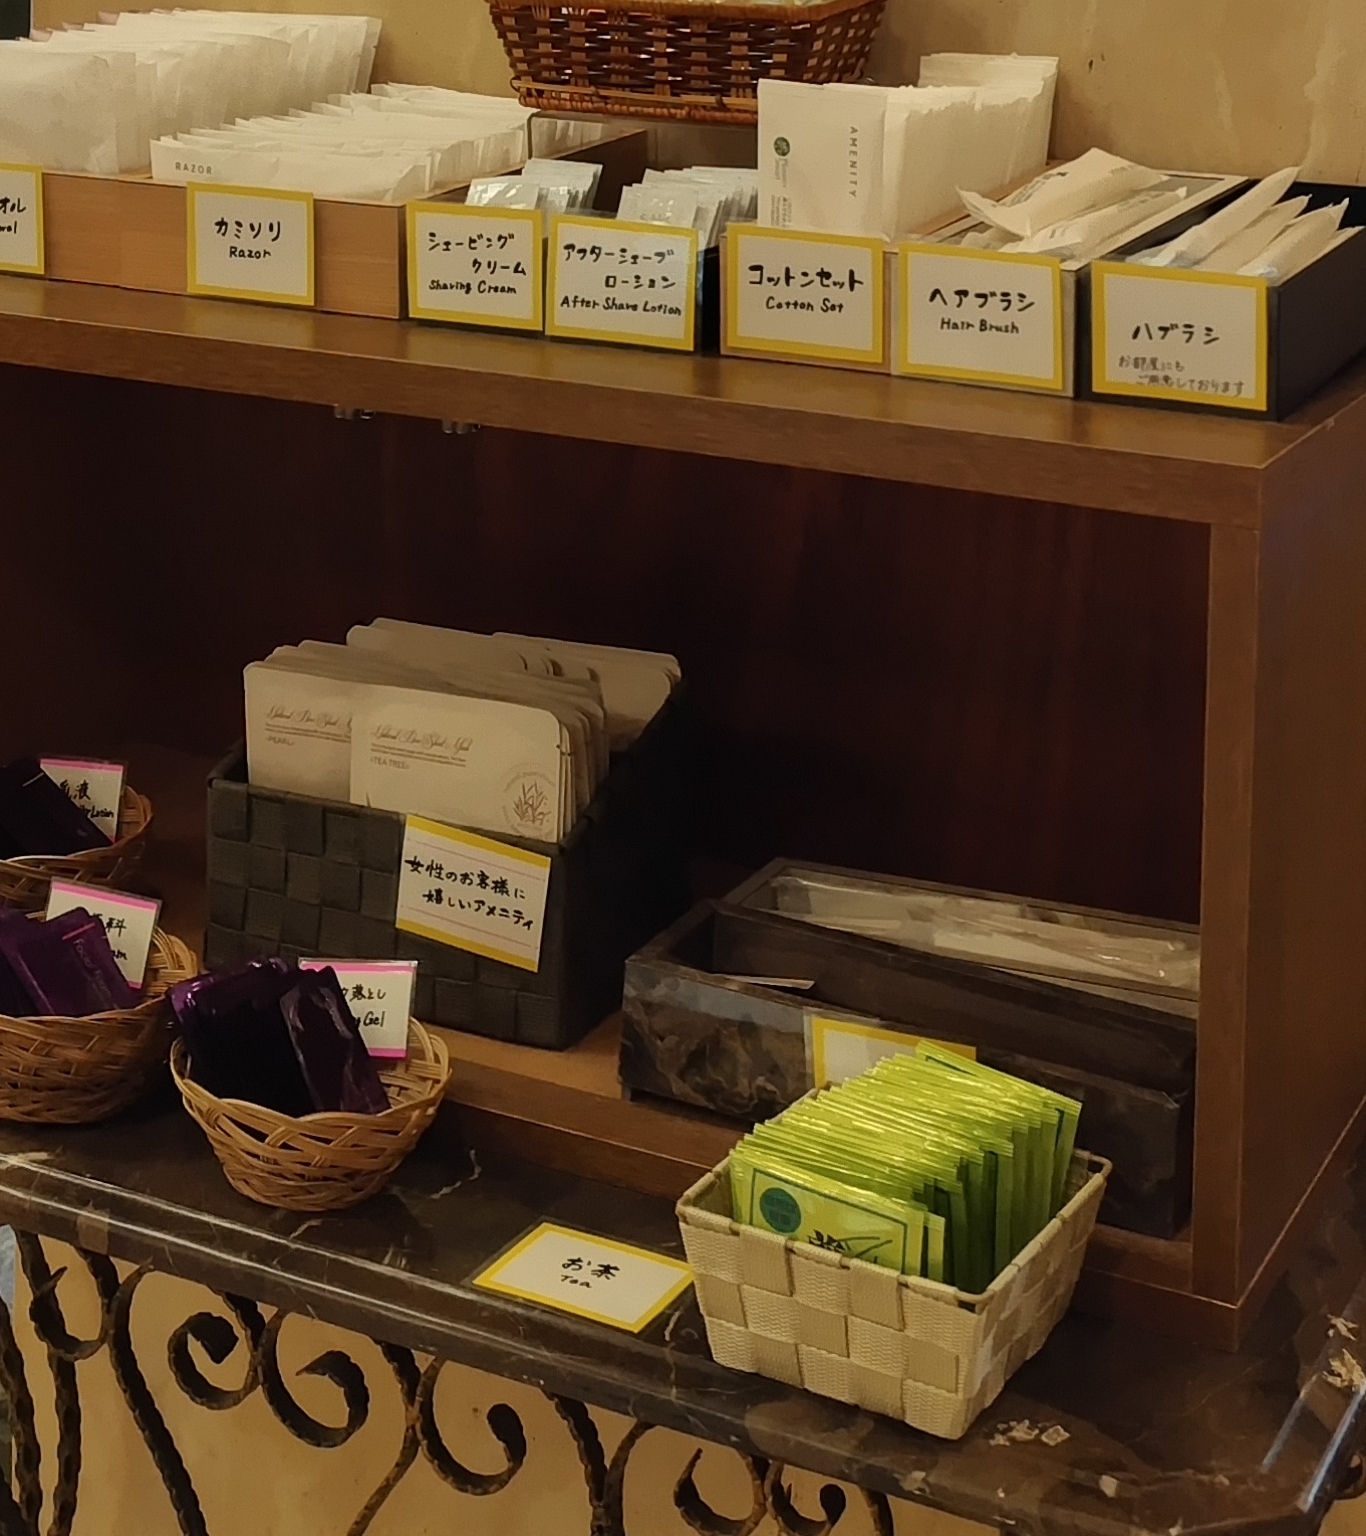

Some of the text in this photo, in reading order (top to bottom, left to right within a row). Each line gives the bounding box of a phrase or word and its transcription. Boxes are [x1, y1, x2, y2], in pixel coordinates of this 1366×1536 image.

[175, 162, 211, 175] RAZOR
[849, 127, 858, 197] AMENITY
[215, 217, 280, 242] カミソリ
[429, 232, 514, 251] シェービング
[229, 245, 272, 260] Razor
[563, 244, 674, 264] アフターシェーブ
[472, 258, 526, 275] クリーム
[429, 280, 516, 294] Shaving Cream
[605, 275, 675, 289] ローション
[748, 265, 863, 292] コットンセット
[560, 295, 681, 316] After Shave Lotion
[766, 296, 843, 313] Cotton Set
[929, 288, 1034, 312] ヘアブラシ
[940, 318, 1019, 333] Hair Brush
[1132, 323, 1219, 344] ハブラシ
[404, 855, 526, 900] 女性のお客様に
[422, 888, 534, 931] 嬉しいアメニティ
[363, 1010, 386, 1028] Gel
[561, 1256, 620, 1282] お茶
[560, 1273, 592, 1290] Tea
